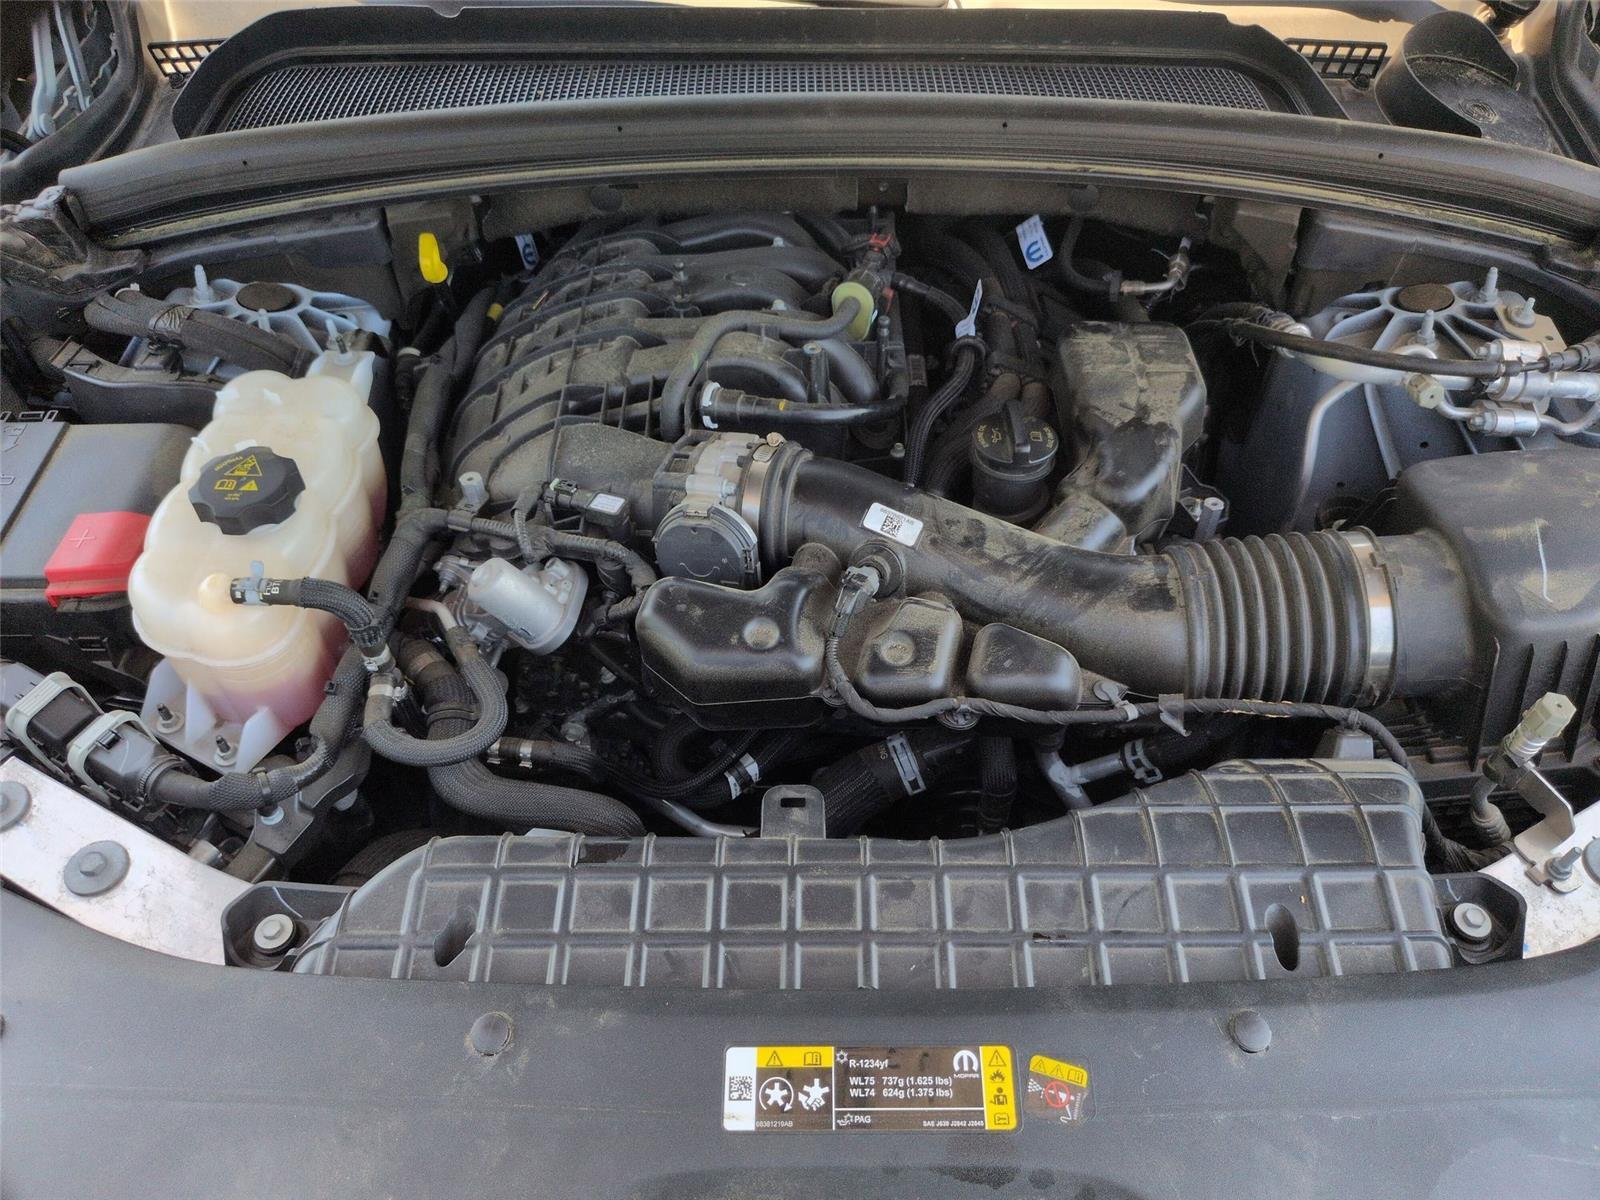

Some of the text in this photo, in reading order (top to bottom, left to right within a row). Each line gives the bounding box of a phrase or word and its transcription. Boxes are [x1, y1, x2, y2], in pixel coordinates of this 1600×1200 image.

[849, 1059, 889, 1070] R-1234yf
[849, 1076, 953, 1087] WL75 737g (1.625 lbs)
[849, 1088, 953, 1099] WL74 624g (1.375 lbs)
[854, 1115, 871, 1124] PAG
